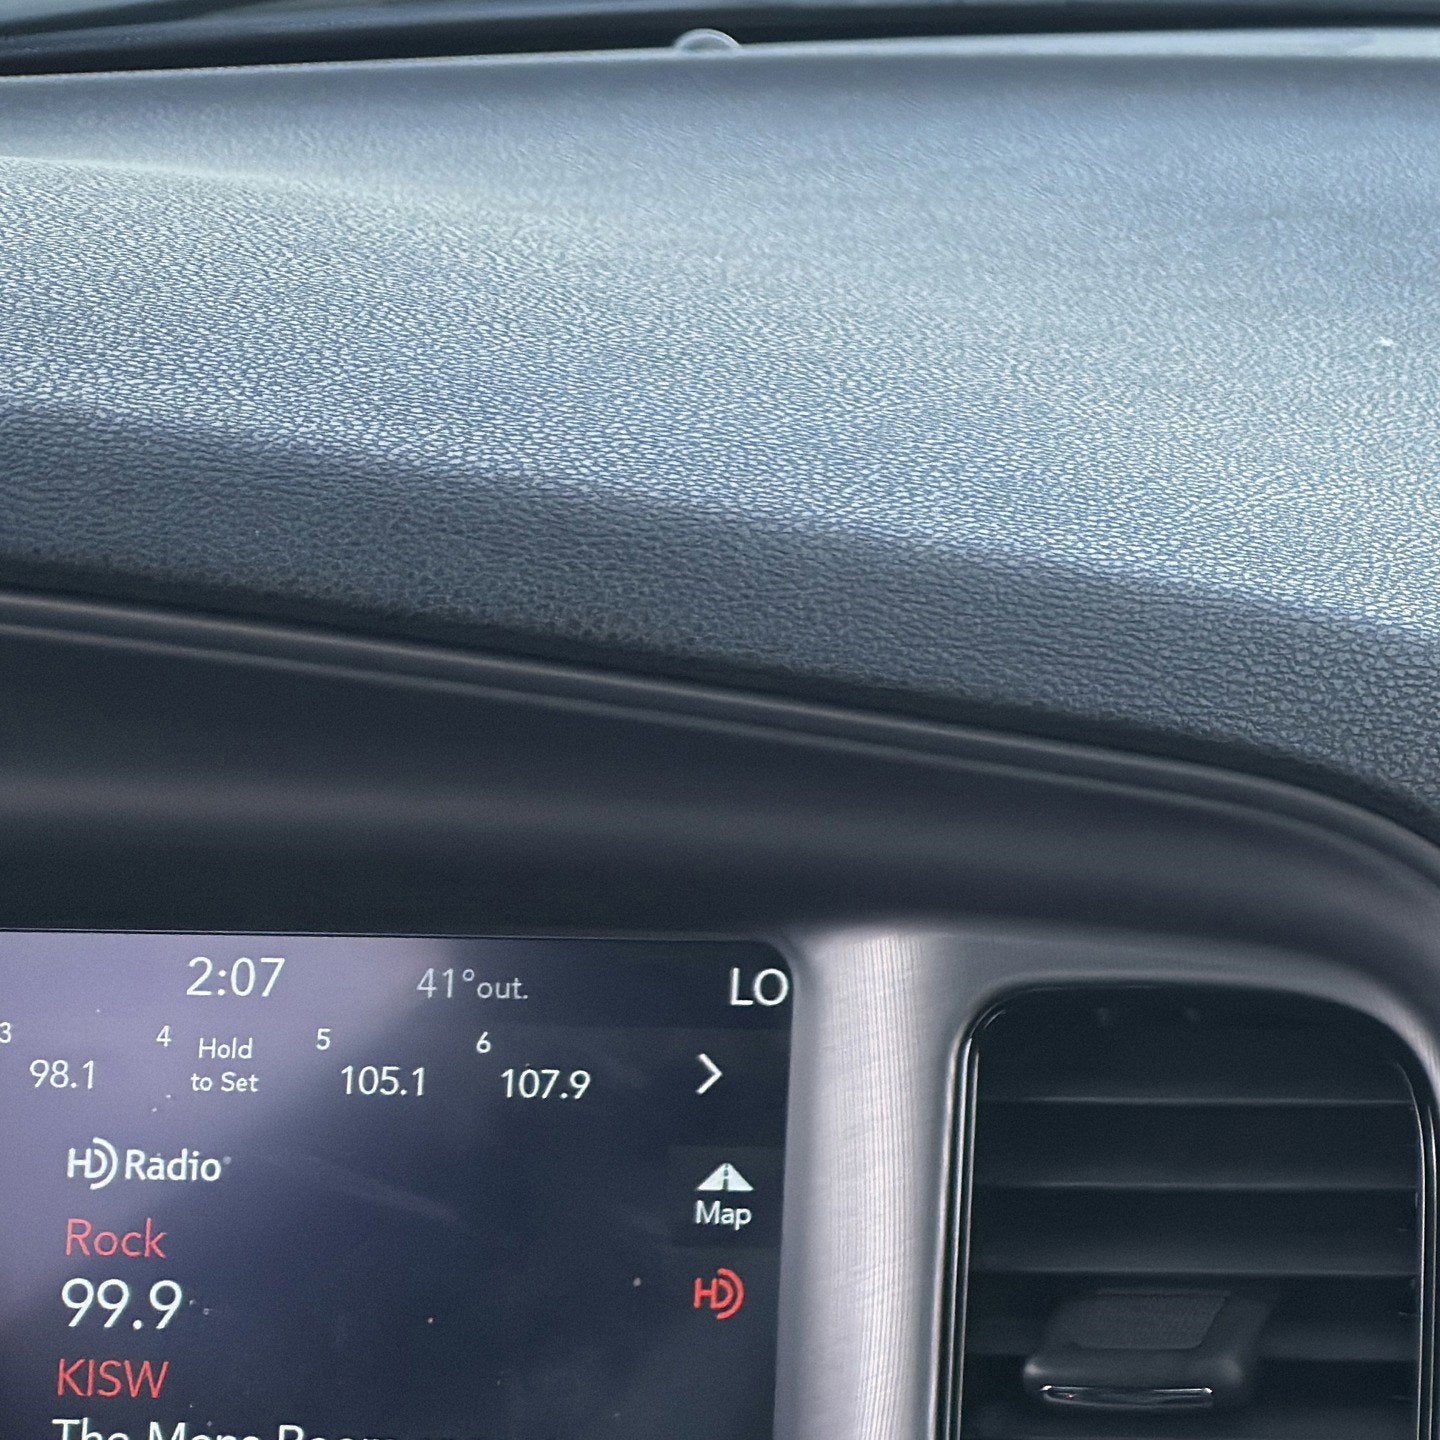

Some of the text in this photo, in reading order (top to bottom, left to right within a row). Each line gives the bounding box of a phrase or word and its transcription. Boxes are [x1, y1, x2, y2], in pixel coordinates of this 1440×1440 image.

[186, 956, 285, 997] 2:07
[729, 967, 789, 1007] LO
[156, 1025, 172, 1047] 4
[198, 1037, 253, 1059] Hold
[316, 1028, 331, 1051] 5
[476, 1031, 492, 1054] 6
[29, 1059, 96, 1089] 98.1
[190, 1071, 259, 1093] to Set
[341, 1065, 426, 1096] 105.1
[501, 1068, 591, 1099] 107.9
[124, 1147, 222, 1182] Radio
[695, 1199, 753, 1231] Map
[65, 1217, 168, 1259] Rock
[61, 1277, 183, 1330] 99.9
[56, 1358, 169, 1399] KISW
